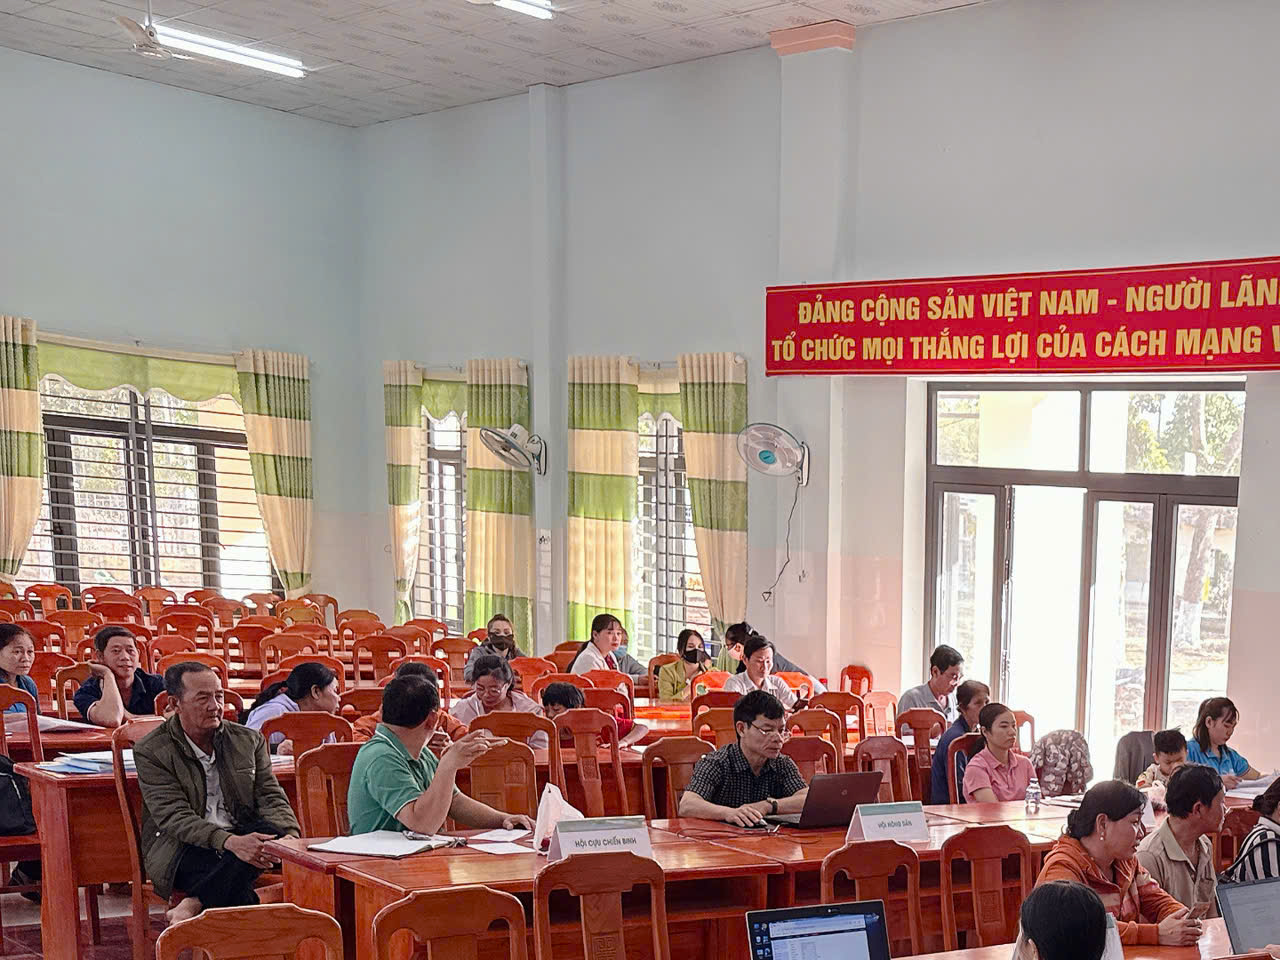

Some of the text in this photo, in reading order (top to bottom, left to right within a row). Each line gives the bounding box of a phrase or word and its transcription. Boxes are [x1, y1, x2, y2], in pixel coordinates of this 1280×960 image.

[799, 294, 855, 323] ĐẢNG
[862, 293, 920, 326] CỘNG
[928, 288, 974, 319] SẢN
[982, 287, 1033, 322] VIỆT
[1040, 289, 1098, 315] NAM
[1126, 276, 1210, 312] NGƯỜI
[772, 330, 796, 361] TỔ
[802, 334, 856, 361] CHỨC
[863, 337, 903, 365] MỌI
[910, 327, 985, 360] THẮNG
[992, 331, 1028, 364] LỢI
[1037, 325, 1087, 358] CỦA
[1096, 325, 1167, 357] CÁCH
[1176, 326, 1261, 360] MẠNG
[575, 838, 587, 848] HỘI
[603, 836, 621, 846] CHIẾN
[622, 837, 637, 845] BINH
